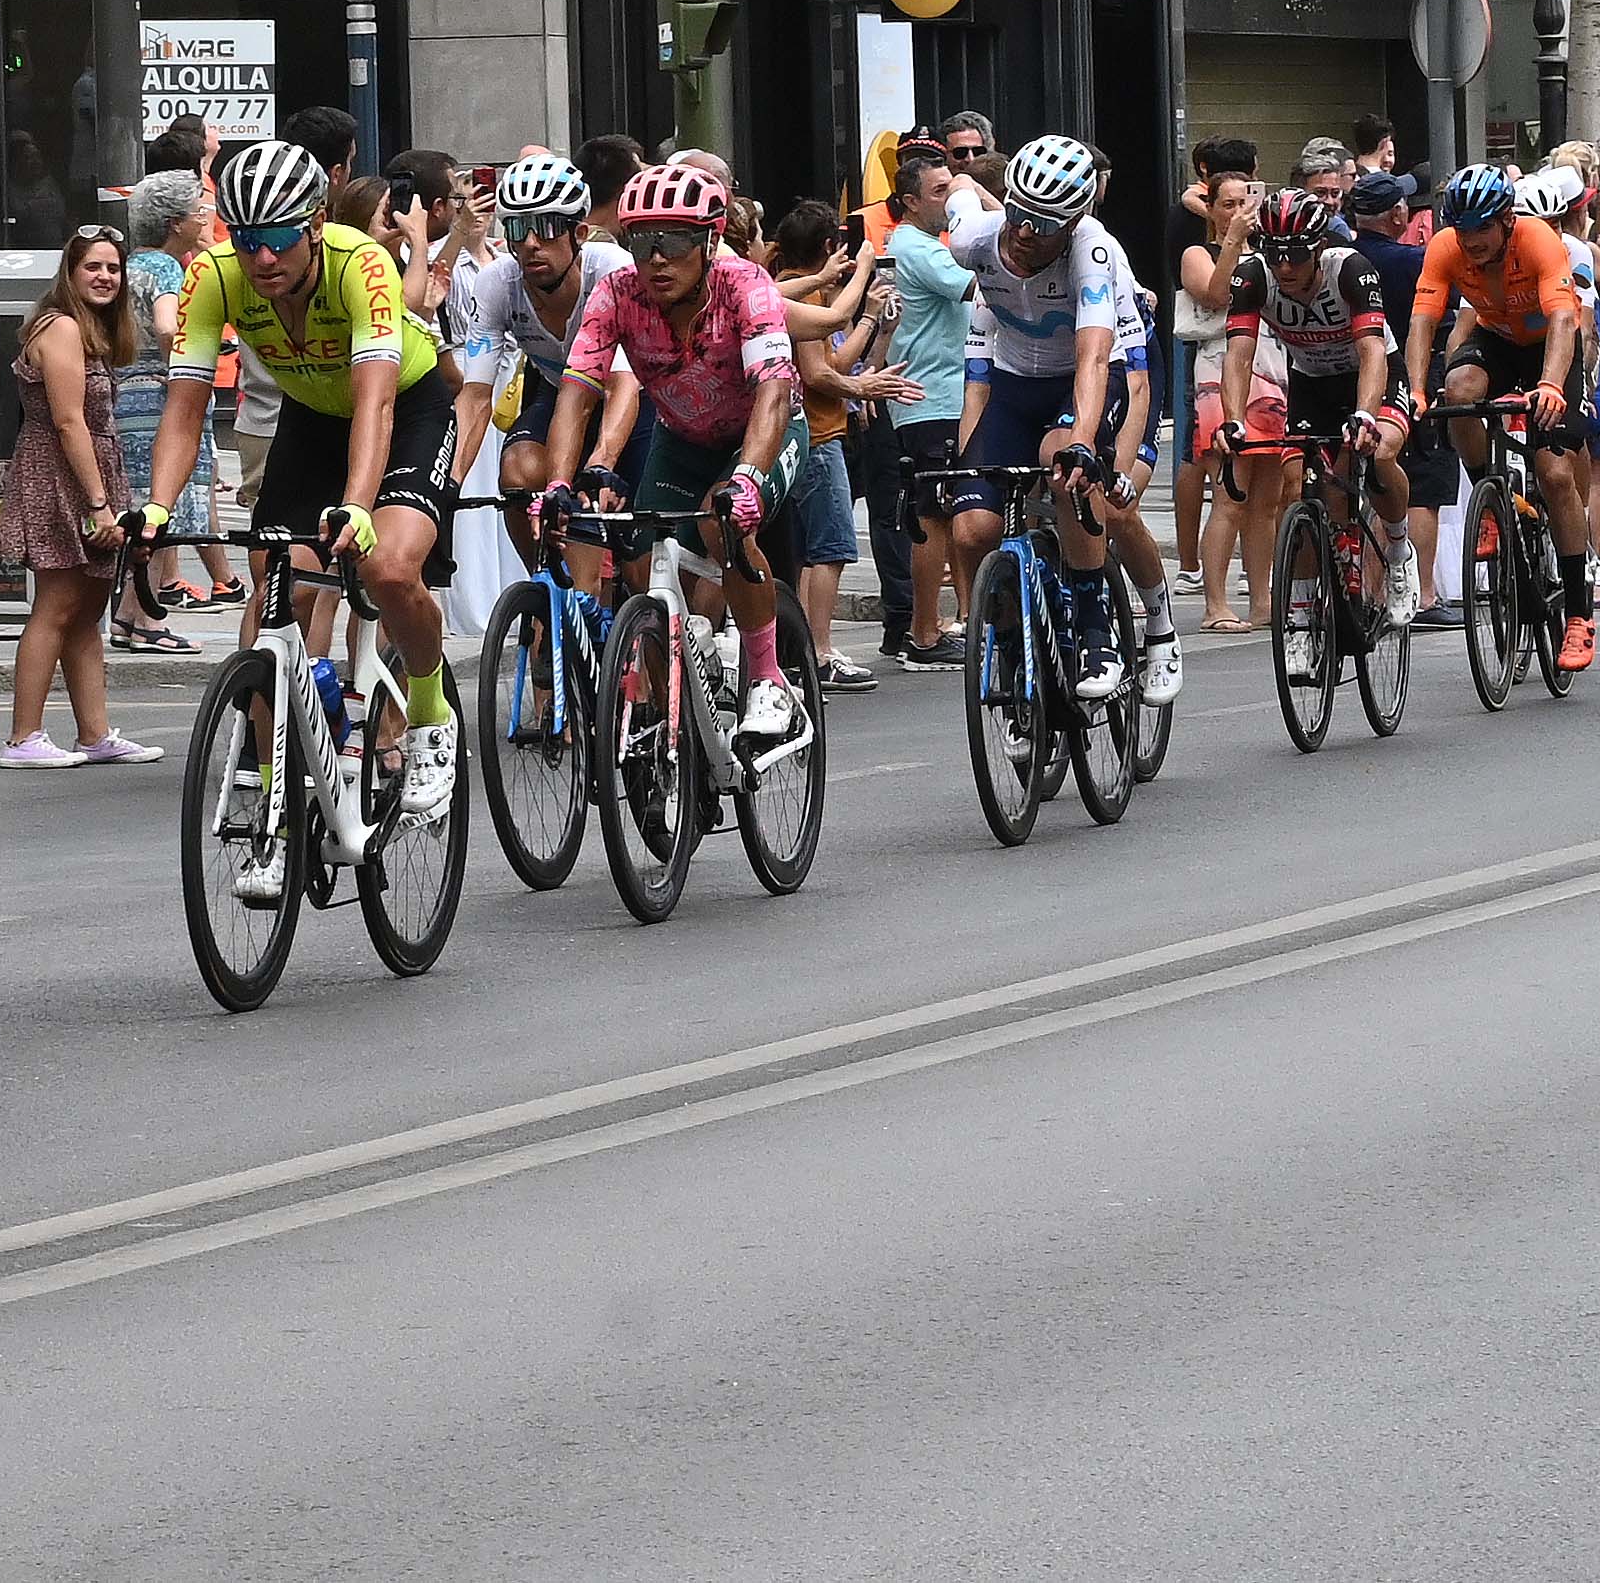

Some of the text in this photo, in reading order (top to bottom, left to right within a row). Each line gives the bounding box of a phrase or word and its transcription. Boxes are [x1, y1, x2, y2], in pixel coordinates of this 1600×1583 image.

[177, 39, 235, 58] MRG
[142, 66, 270, 94] ALQUILA
[198, 99, 229, 119] 77
[238, 99, 269, 119] 77
[355, 250, 394, 339] ARKEA
[1276, 299, 1346, 327] UAE
[272, 722, 284, 811] CANYON
